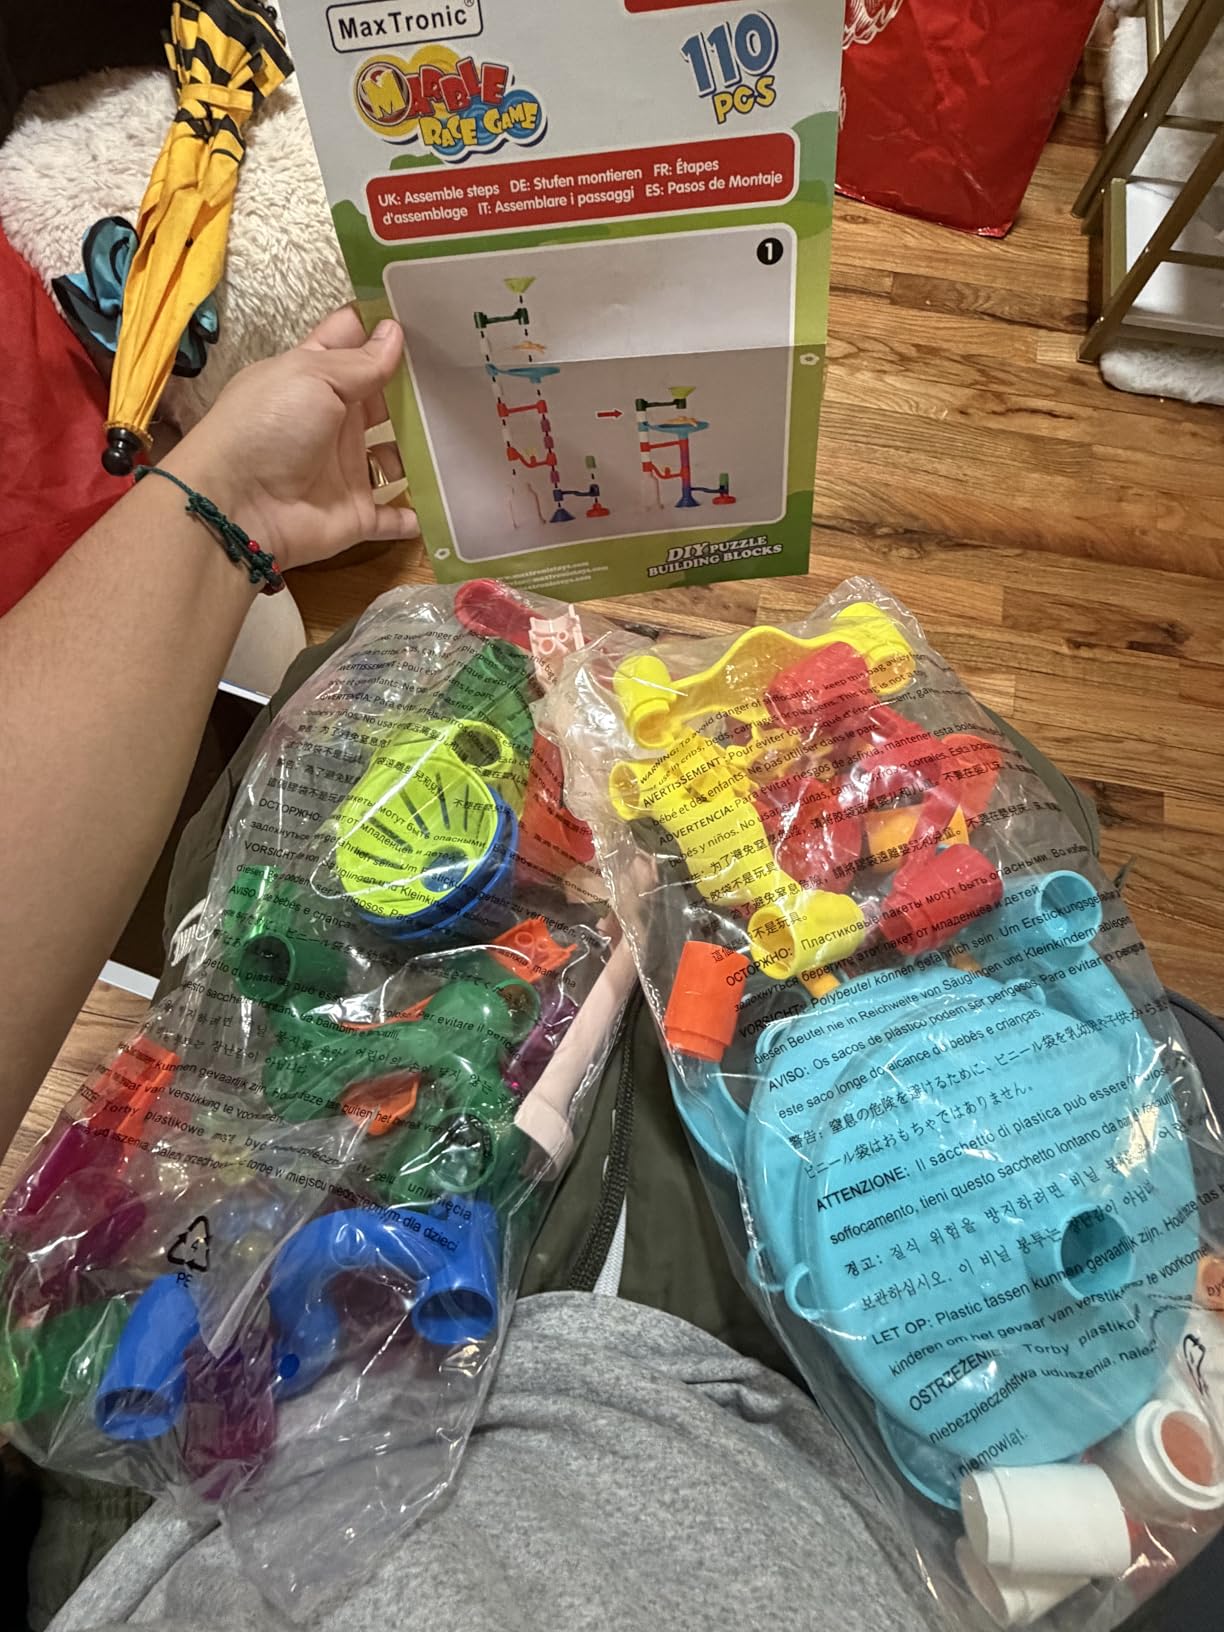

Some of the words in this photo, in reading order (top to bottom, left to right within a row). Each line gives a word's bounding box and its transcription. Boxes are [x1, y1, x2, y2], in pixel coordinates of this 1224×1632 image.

[338, 5, 467, 40] MaxTronic
[681, 12, 777, 95] 110
[361, 57, 509, 121] MARBLE
[713, 75, 776, 124] PCS
[418, 114, 478, 147] RACE
[483, 102, 538, 134] GAME
[378, 194, 401, 207] UK:
[404, 187, 464, 204] Assemble
[467, 183, 500, 199] steps
[510, 180, 530, 193] DE:
[534, 174, 574, 190] Stufen
[578, 168, 642, 186] montieren
[654, 163, 672, 177] FR:
[676, 158, 719, 176] Étapes
[383, 206, 468, 225] d'assemblage
[478, 203, 492, 216] IT:
[495, 194, 567, 214] Assemblare
[570, 192, 575, 205] i
[578, 186, 635, 207] passaggi
[646, 184, 664, 198] ES:
[668, 180, 705, 194] Pasos
[708, 176, 725, 190] de
[729, 171, 783, 189] Montaje
[649, 554, 720, 577] BUILDING
[723, 544, 783, 562] BLOCKS
[667, 542, 709, 562] DIY
[709, 535, 768, 554] PUZZLE
[716, 702, 751, 720] danger
[823, 677, 847, 691] keep
[847, 670, 867, 682] this
[867, 661, 886, 676] bag
[643, 757, 721, 808] AVERTISSEMENT
[728, 744, 755, 761] Pour
[755, 731, 785, 749] éviter
[786, 724, 807, 737] tout
[706, 732, 734, 748] beds,
[659, 804, 735, 845] ADVERTENCIA:
[735, 791, 759, 809] Para
[793, 763, 830, 783] riesgos
[832, 758, 845, 769] de
[885, 731, 932, 751] mantener
[933, 725, 953, 737] esta
[679, 803, 690, 815] et
[707, 773, 747, 798] enfants.
[764, 757, 783, 771] pas
[819, 732, 845, 747] dans
[377, 805, 405, 826] могут
[707, 829, 740, 848] niños.
[740, 819, 756, 832] No
[758, 807, 779, 823] usar
[726, 947, 793, 987] ОСТОРЖНО:
[800, 915, 879, 951] Пластиковые
[883, 898, 923, 919] пакеты
[925, 886, 957, 904] могут
[958, 876, 987, 892] быть
[883, 932, 914, 951] пакет
[753, 1042, 787, 1065] diesen
[787, 1026, 825, 1049] Beutel
[827, 1018, 845, 1033] nie
[848, 1014, 858, 1025] in
[858, 993, 919, 1021] Reichweite
[920, 985, 941, 1000] von
[942, 959, 1004, 990] Säuglingen
[1004, 951, 1024, 966] und
[1024, 927, 1097, 960] Kleinkindern
[810, 977, 872, 1009] Polybeutel
[873, 963, 915, 986] können
[971, 934, 998, 950] sein.
[999, 923, 1021, 938] Um
[438, 1015, 475, 1032] evitare
[768, 1066, 810, 1092] AVISO:
[812, 1057, 830, 1071] Os
[831, 1043, 866, 1062] sacos
[867, 1033, 883, 1046] de
[884, 1019, 928, 1042] plástico
[929, 1005, 968, 1026] podem
[968, 997, 985, 1010] ser
[1039, 970, 1066, 985] Para
[1067, 956, 1103, 976] evitar
[778, 1101, 804, 1119] este
[806, 1090, 834, 1108] saco
[836, 1074, 868, 1096] longe
[886, 1050, 930, 1072] alcance
[950, 1029, 985, 1049] bebês
[997, 1007, 1044, 1031] crianças.
[144, 1110, 205, 1137] plastikowe
[816, 1165, 910, 1212] ATTENZIONE:
[929, 1131, 995, 1167] sacchetto
[997, 1126, 1011, 1138] di
[1012, 1106, 1062, 1134] plastica
[1063, 1095, 1087, 1115] può
[1089, 1079, 1128, 1102] essere
[285, 1170, 328, 1191] miejscu
[402, 1216, 421, 1233] dla
[424, 1226, 459, 1253] dzieci
[830, 1203, 919, 1245] soffocamento,
[919, 1188, 949, 1209] tieni
[950, 1172, 996, 1199] questo
[999, 1146, 1056, 1179] sacchetto
[1056, 1128, 1101, 1152] lontano
[1102, 1121, 1117, 1134] da
[844, 1254, 883, 1277] 경고:
[890, 1238, 920, 1261] 질식
[930, 1217, 976, 1245] 위험을
[1070, 1166, 1101, 1188] 비닐
[872, 1326, 900, 1345] LET
[904, 1318, 933, 1334] OP:
[935, 1301, 983, 1325] Plastic
[984, 1284, 1031, 1309] tassen
[1032, 1262, 1084, 1289] kunnen
[1086, 1236, 1138, 1273] gevaarlijk
[1138, 1227, 1163, 1248] zijn.
[958, 1258, 975, 1276] 이
[979, 1244, 1011, 1268] 비닐
[889, 1342, 943, 1376] kinderen
[946, 1335, 968, 1347] om
[970, 1329, 994, 1342] het
[997, 1318, 1046, 1340] gevaar
[1048, 1304, 1074, 1323] van
[1022, 1342, 1070, 1357] Torby
[929, 1368, 1038, 1445] niebezpieczeństwa
